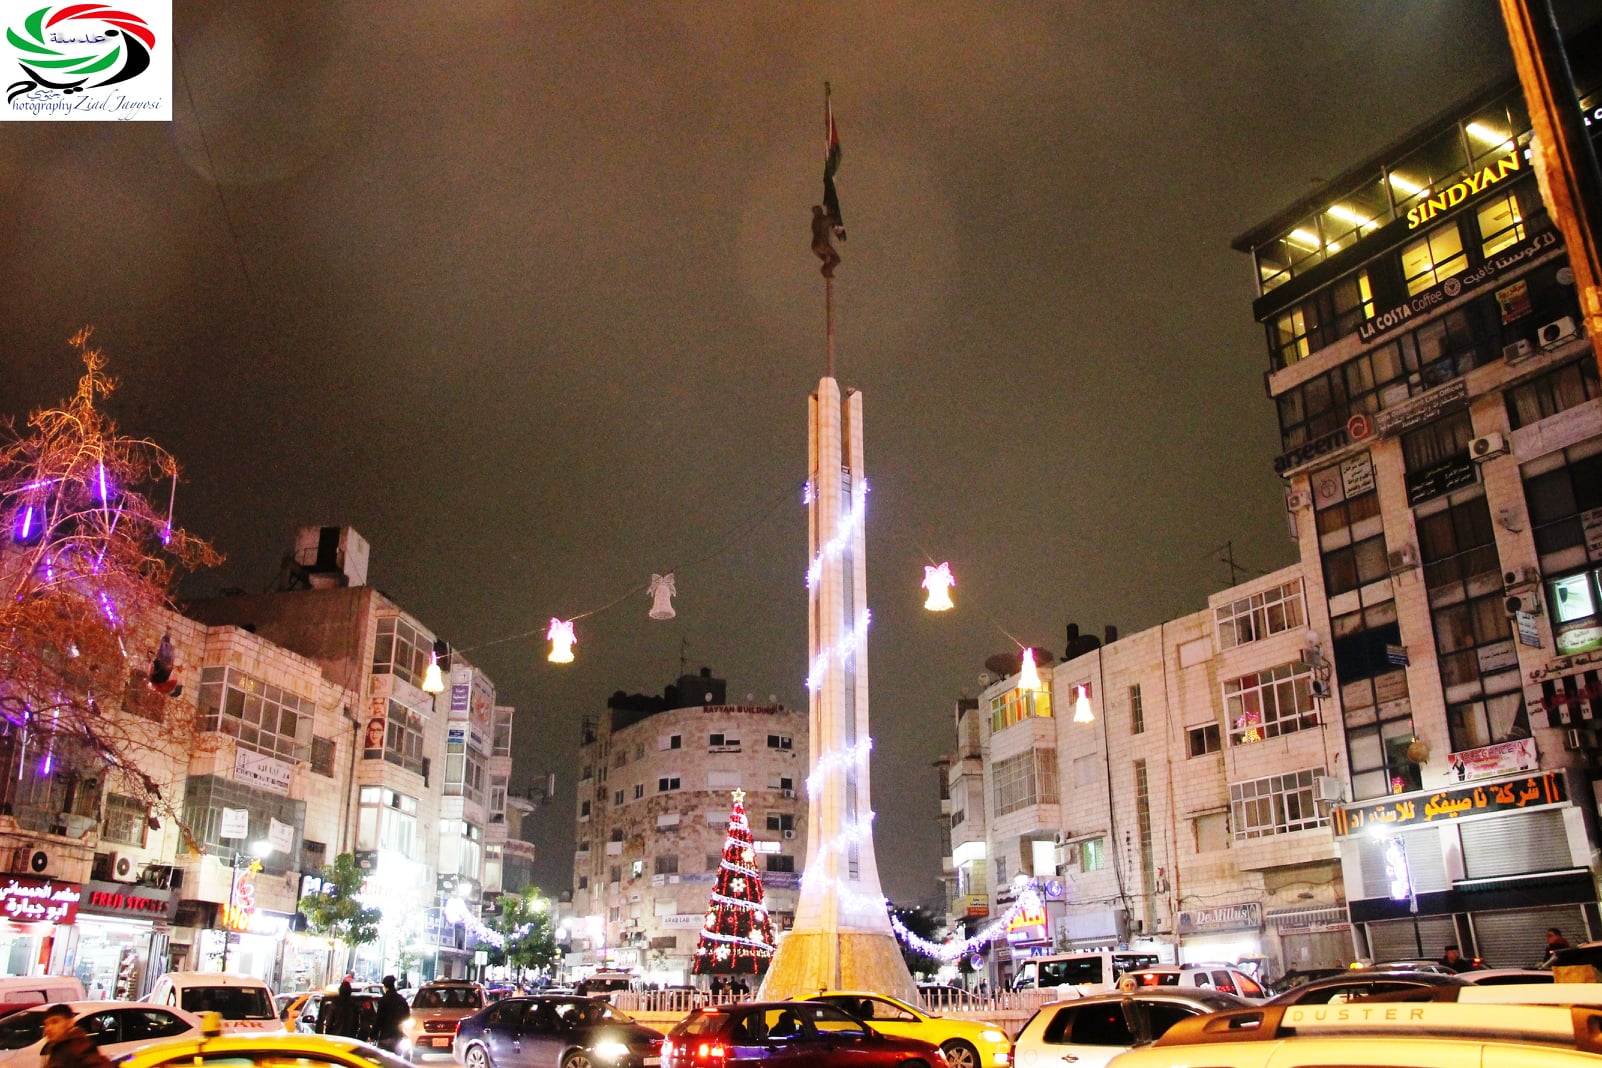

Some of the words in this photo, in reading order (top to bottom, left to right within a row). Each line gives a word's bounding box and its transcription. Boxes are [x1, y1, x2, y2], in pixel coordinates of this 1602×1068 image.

[1407, 150, 1521, 230] SINDYAN
[1360, 324, 1375, 338] LA
[1376, 303, 1412, 330] COSTA
[1411, 289, 1443, 312] Coffee
[1489, 777, 1540, 807] شركة
[50, 887, 80, 902] مطعم
[4, 897, 46, 917] جبارة
[46, 902, 69, 920] ابو
[1196, 911, 1209, 925] De
[1212, 907, 1248, 922] Millus
[1292, 1008, 1424, 1022] DUSTER
[221, 1021, 265, 1029] TAR
